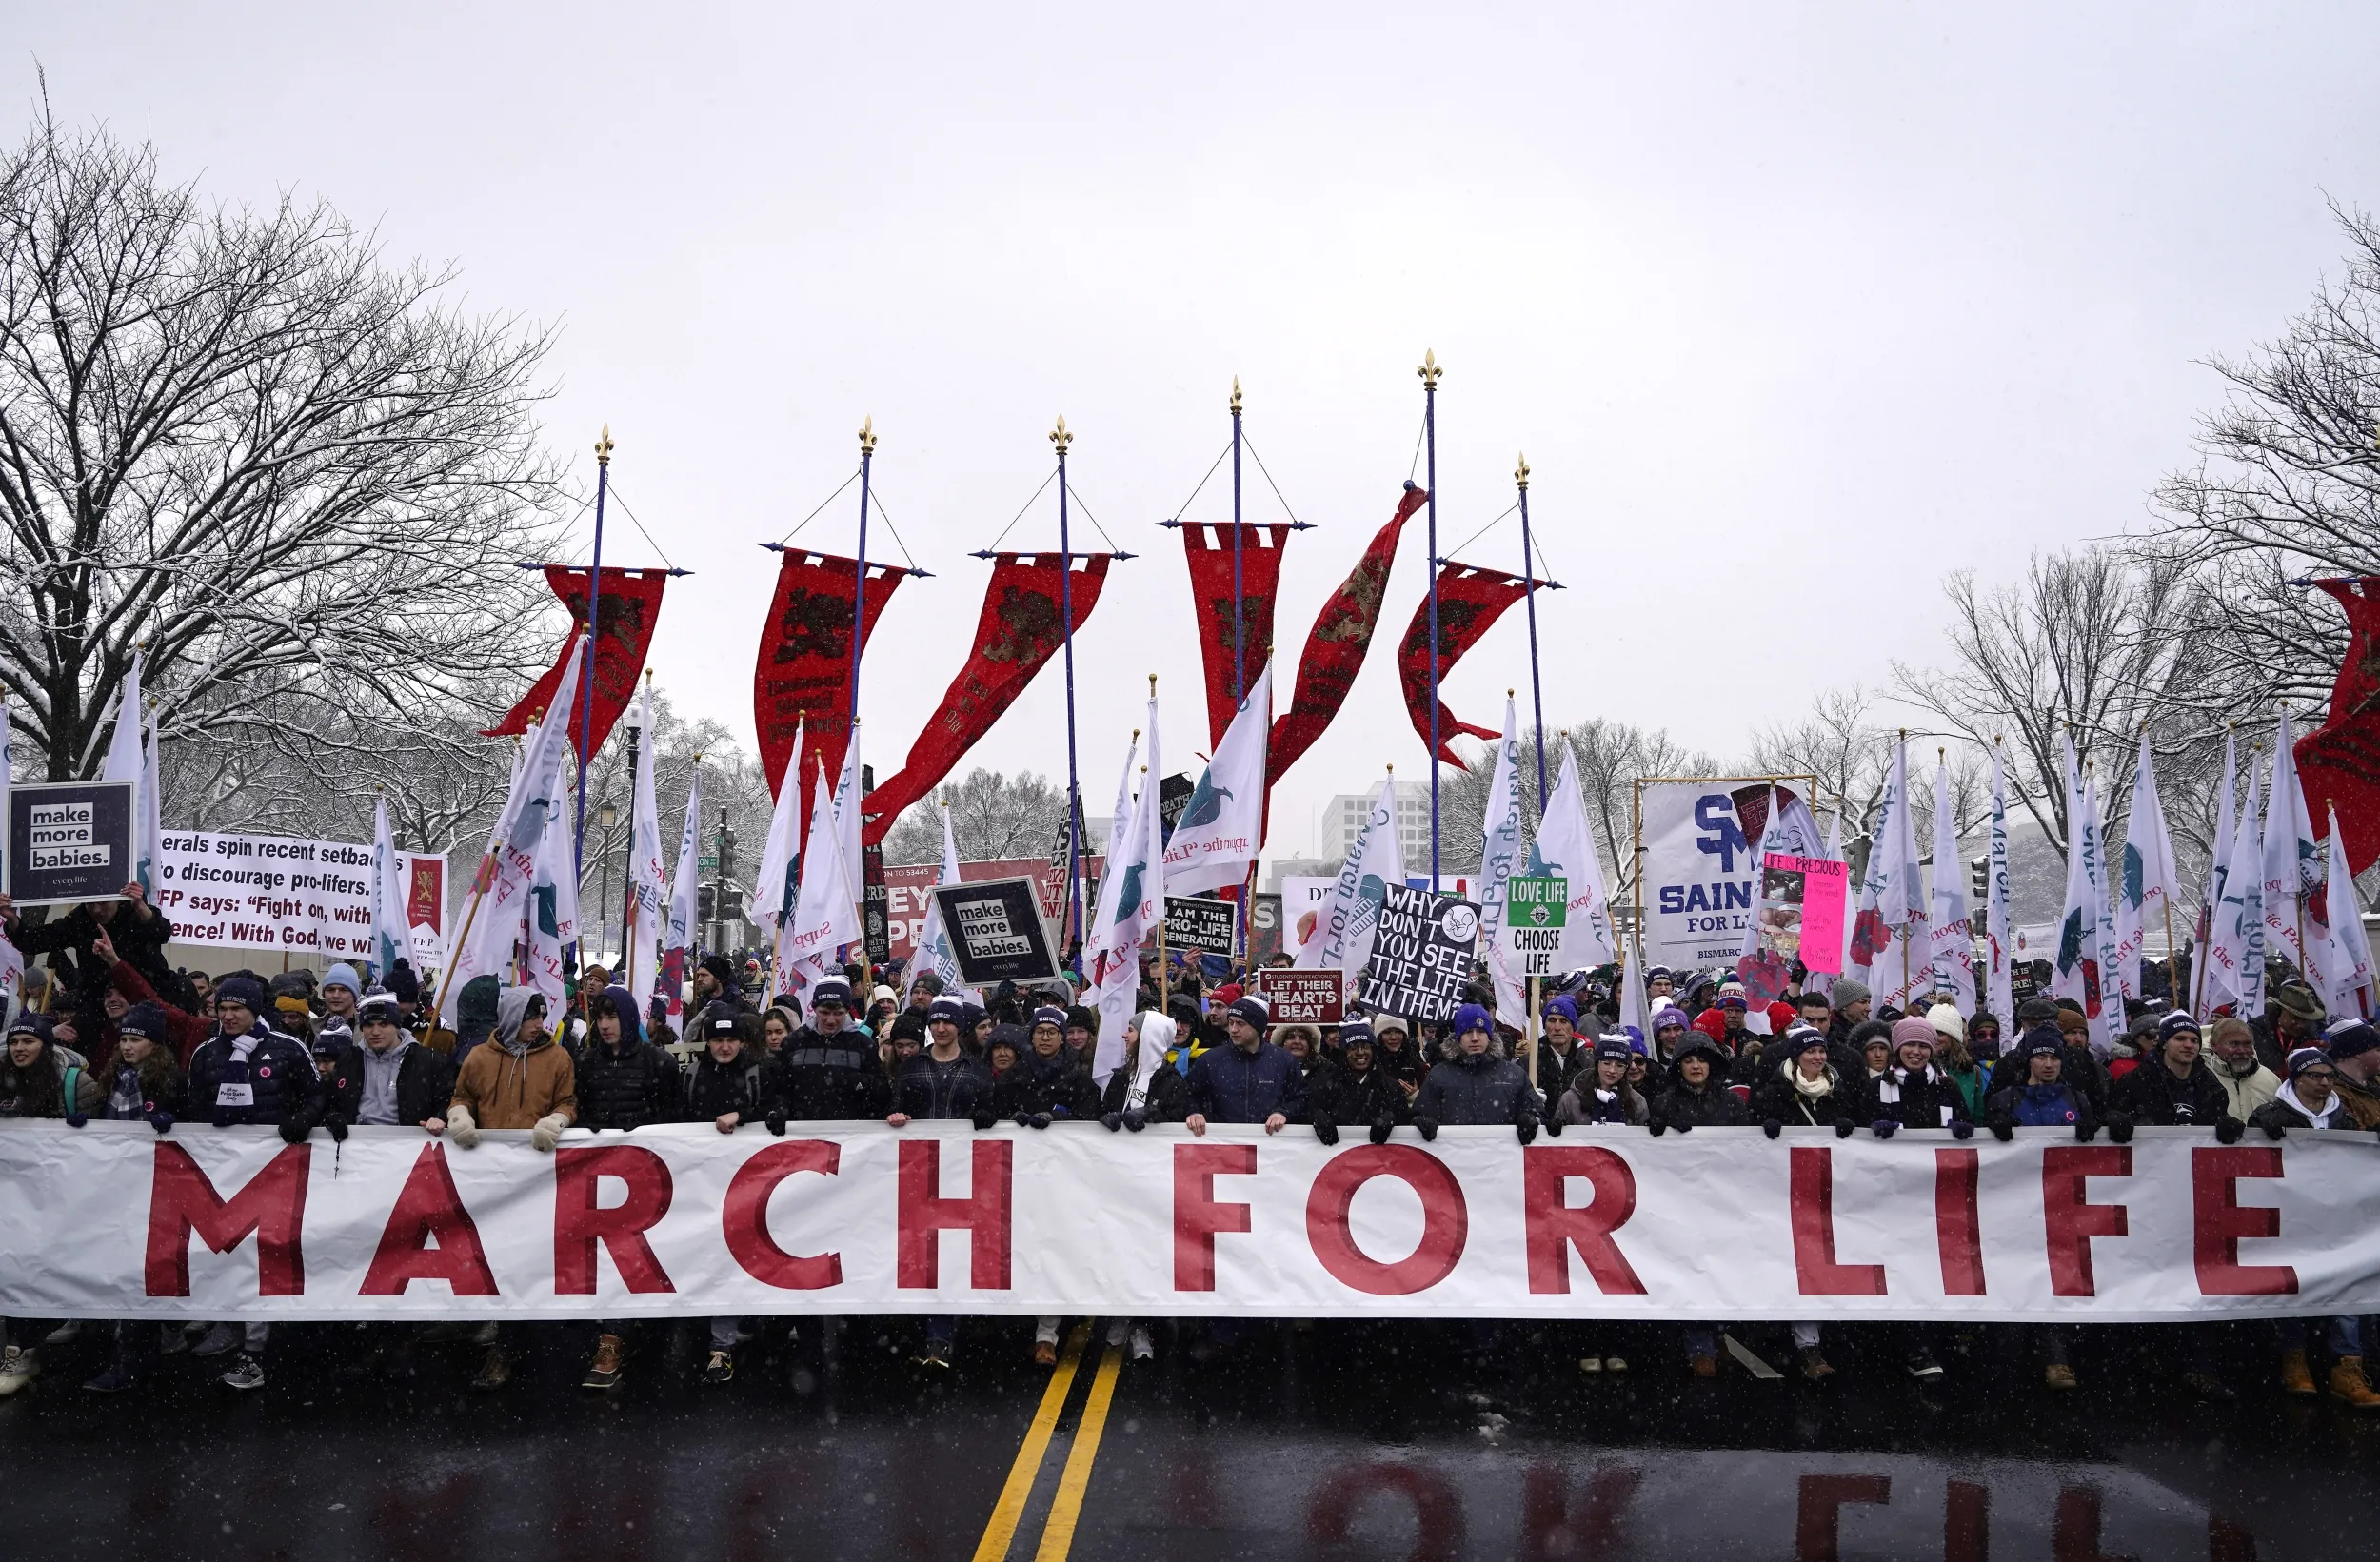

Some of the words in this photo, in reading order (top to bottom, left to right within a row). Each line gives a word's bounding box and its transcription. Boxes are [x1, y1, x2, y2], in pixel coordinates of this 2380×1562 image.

[33, 805, 89, 824] make
[32, 828, 89, 843] more
[32, 849, 109, 868] babies.
[161, 835, 209, 853] erals
[216, 838, 252, 859] spin
[258, 843, 315, 860] recent
[320, 847, 404, 871] setbas
[1764, 853, 1783, 869] LIFE
[1795, 858, 1841, 876] PRECIOUS
[161, 861, 174, 879] o
[181, 862, 284, 890] discourage
[291, 873, 369, 896] pro-lifers.
[1386, 883, 1443, 918] WHY
[1512, 880, 1542, 902] LOVE
[1545, 880, 1565, 902] LIFE
[1659, 880, 1752, 915] SAIN
[189, 895, 240, 915] says:
[308, 903, 327, 923] on,
[334, 905, 371, 924] with
[959, 902, 1002, 920] make
[1174, 908, 1196, 919] AM
[1202, 911, 1227, 922] THE
[964, 921, 1007, 936] more
[1164, 919, 1231, 938] PRO-LIFE
[1687, 916, 1728, 933] FOR
[171, 922, 225, 939] ence!
[232, 922, 275, 942] With
[282, 926, 321, 950] God,
[325, 935, 346, 950] we
[352, 937, 371, 954] wi
[413, 937, 434, 946] TFP
[1163, 932, 1228, 948] GENERATION
[1514, 929, 1559, 951] CHOOSE
[969, 939, 1030, 957] babies.
[1378, 930, 1419, 961] YOU
[1421, 944, 1471, 976] SEE
[1697, 948, 1742, 959] BISMARC
[1525, 953, 1550, 974] LIFE
[1270, 980, 1290, 990] LET
[1299, 980, 1334, 990] THEIR
[1372, 954, 1418, 988] THE
[1416, 967, 1468, 1000] LIFE
[2012, 979, 2032, 990] RE!
[1267, 991, 1337, 1004] HEARTS
[1359, 978, 1396, 1009] IN
[1399, 987, 1462, 1020] THEM?
[1279, 1005, 1324, 1018] BEAT
[147, 1140, 1011, 1295] MARCH
[1175, 1144, 1645, 1295] FOR
[1791, 1147, 2295, 1295] LIFE
